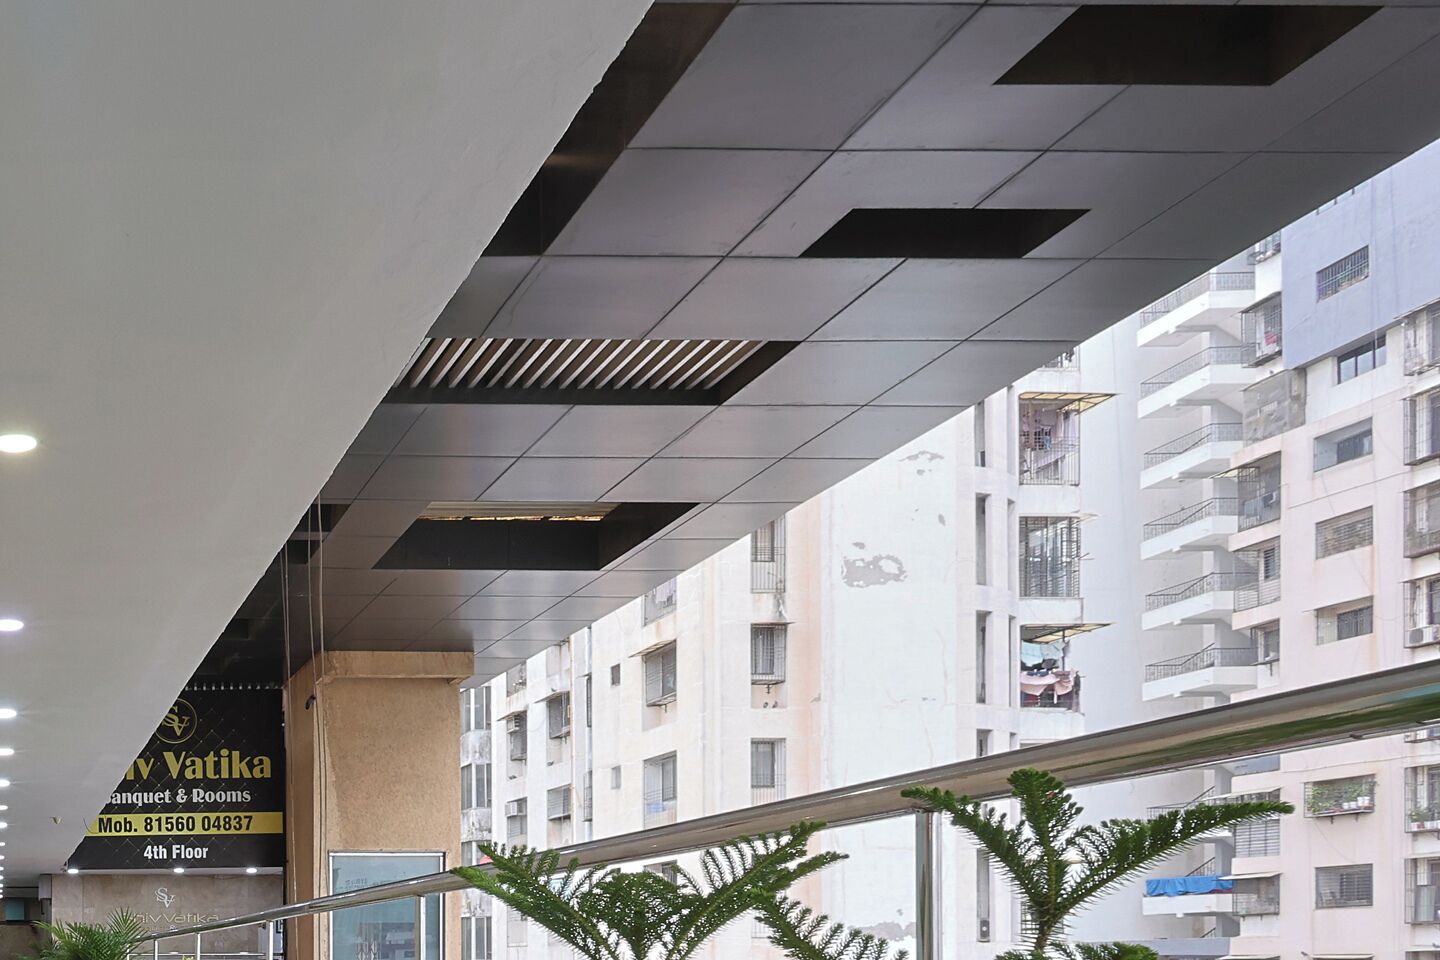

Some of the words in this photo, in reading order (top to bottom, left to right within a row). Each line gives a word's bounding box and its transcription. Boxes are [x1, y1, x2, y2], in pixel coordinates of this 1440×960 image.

[162, 748, 272, 780] Vatika
[107, 789, 172, 806] anquet
[175, 788, 188, 803] &
[192, 788, 252, 803] Rooms
[98, 816, 138, 833] Mob.
[144, 816, 196, 832] 81560
[201, 815, 253, 831] 04837
[143, 845, 168, 860] 4th
[172, 844, 209, 859] Floor
[162, 912, 219, 924] Vatika
